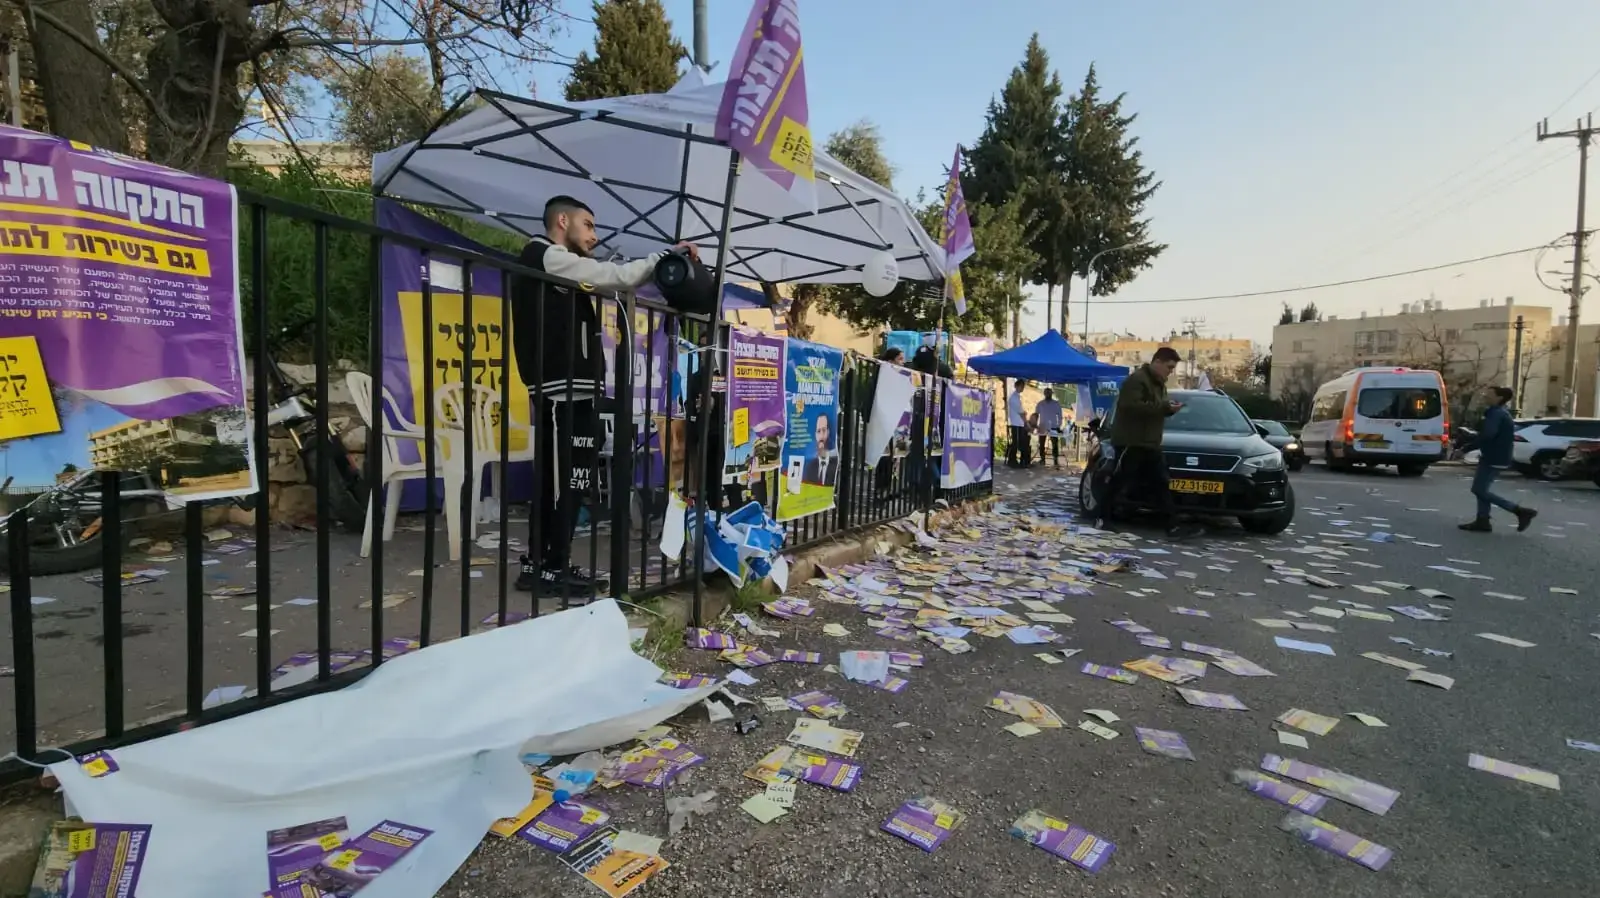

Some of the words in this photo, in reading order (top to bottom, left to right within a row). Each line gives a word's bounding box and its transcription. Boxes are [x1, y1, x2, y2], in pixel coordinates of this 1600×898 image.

[0, 159, 59, 202] תנ
[72, 170, 205, 229] התקווה
[63, 233, 159, 264] בשירות
[166, 249, 197, 270] גם
[62, 265, 80, 274] של
[10, 287, 48, 295] הטובים
[95, 289, 110, 299] של
[21, 298, 62, 307] מהפכת
[37, 310, 57, 319] זמן
[96, 312, 107, 320] כי
[438, 322, 502, 352] יוסי
